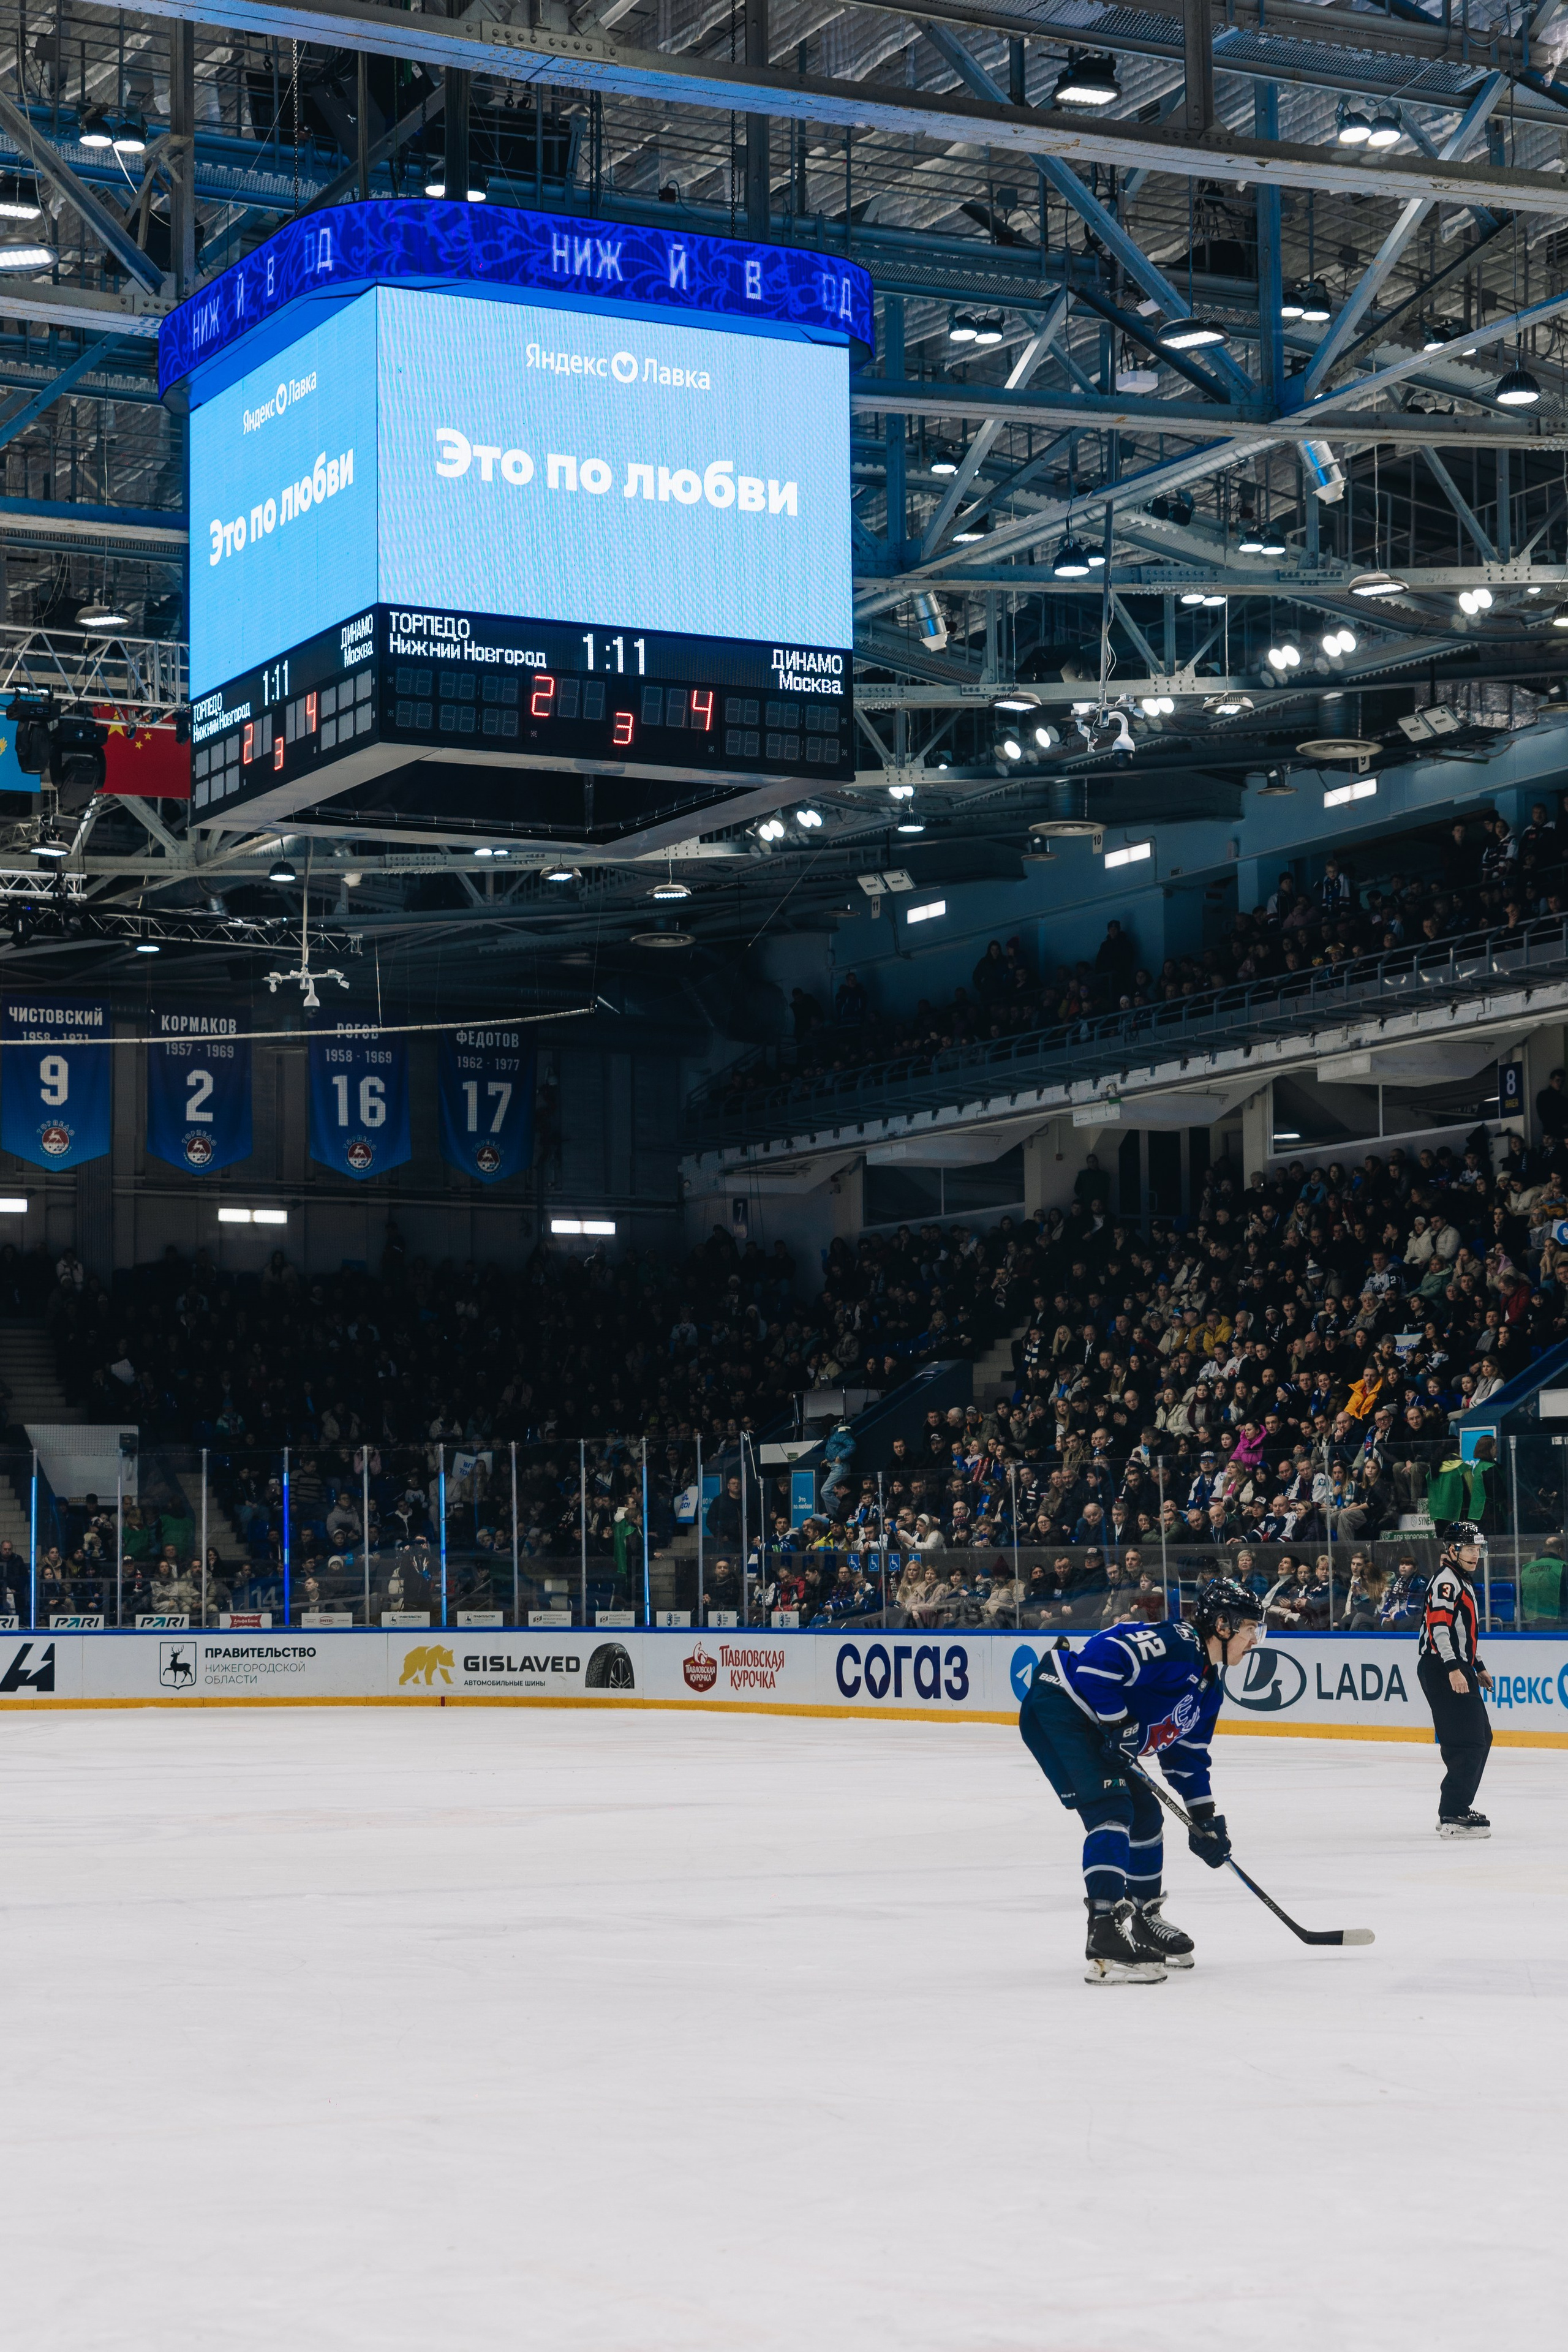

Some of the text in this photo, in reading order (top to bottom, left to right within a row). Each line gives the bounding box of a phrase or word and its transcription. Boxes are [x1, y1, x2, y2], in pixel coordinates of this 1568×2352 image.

[526, 343, 710, 391] Яндекс Лавка
[243, 371, 317, 435] Яндекс Лавка
[436, 428, 798, 516] Это по любви
[209, 448, 354, 567] Это по любви
[341, 614, 374, 650] ДИНАМО
[390, 611, 470, 641] ТОРПЕДО
[344, 640, 374, 668] Москва
[390, 633, 546, 668] Нижний Новгород
[583, 633, 645, 676] 1:11
[771, 649, 843, 676] ДИНАМО
[263, 660, 289, 706] 1:11
[531, 676, 554, 717] 2
[778, 673, 843, 695] Москва
[193, 693, 222, 725] ТОРПЕДО
[218, 701, 251, 732] Новгород
[306, 692, 317, 733] 4
[692, 690, 714, 731] 4
[613, 712, 634, 745] 3
[243, 723, 253, 765] 2
[274, 737, 284, 771] 3
[1093, 834, 1101, 846] 10
[873, 901, 879, 911] 11
[9, 1006, 104, 1026] ЧИСТОВСКИЙ
[162, 1015, 237, 1035] КОРМАКОВ
[165, 1041, 192, 1057] 1957
[206, 1043, 234, 1059] 1969
[456, 1030, 519, 1048] ФЕДОТОВ
[325, 1049, 353, 1063] 1958
[366, 1049, 392, 1064] 1969
[457, 1055, 483, 1069] 1962
[496, 1058, 520, 1071] 1977
[40, 1055, 69, 1106] 9
[1506, 1069, 1516, 1095] 8
[186, 1069, 214, 1123] 2
[332, 1074, 386, 1128] 16
[462, 1080, 512, 1133] 17
[37, 1120, 75, 1136] ТОРПЕДО
[181, 1129, 217, 1147] ТОРПЕДО
[251, 1585, 279, 1608] 14
[1442, 1583, 1452, 1598] 3
[0, 1618, 14, 1628] RI
[55, 1617, 100, 1628] PARI
[140, 1616, 185, 1627] PARI
[205, 1647, 317, 1659] ПРАВИТЕЛЬСТВО
[1125, 1629, 1167, 1660] 92
[205, 1661, 306, 1673] НИЖЕГОРОДСКОЙ
[464, 1656, 581, 1673] GISLAVED
[719, 1645, 785, 1672] ПАВЛОВСКАЯ
[205, 1675, 258, 1684] ОБЛАСТИ
[730, 1669, 776, 1691] КУРОЧКА
[1039, 1673, 1063, 1687] BAU
[1316, 1662, 1408, 1703] LADA
[1479, 1676, 1553, 1709] ндекс
